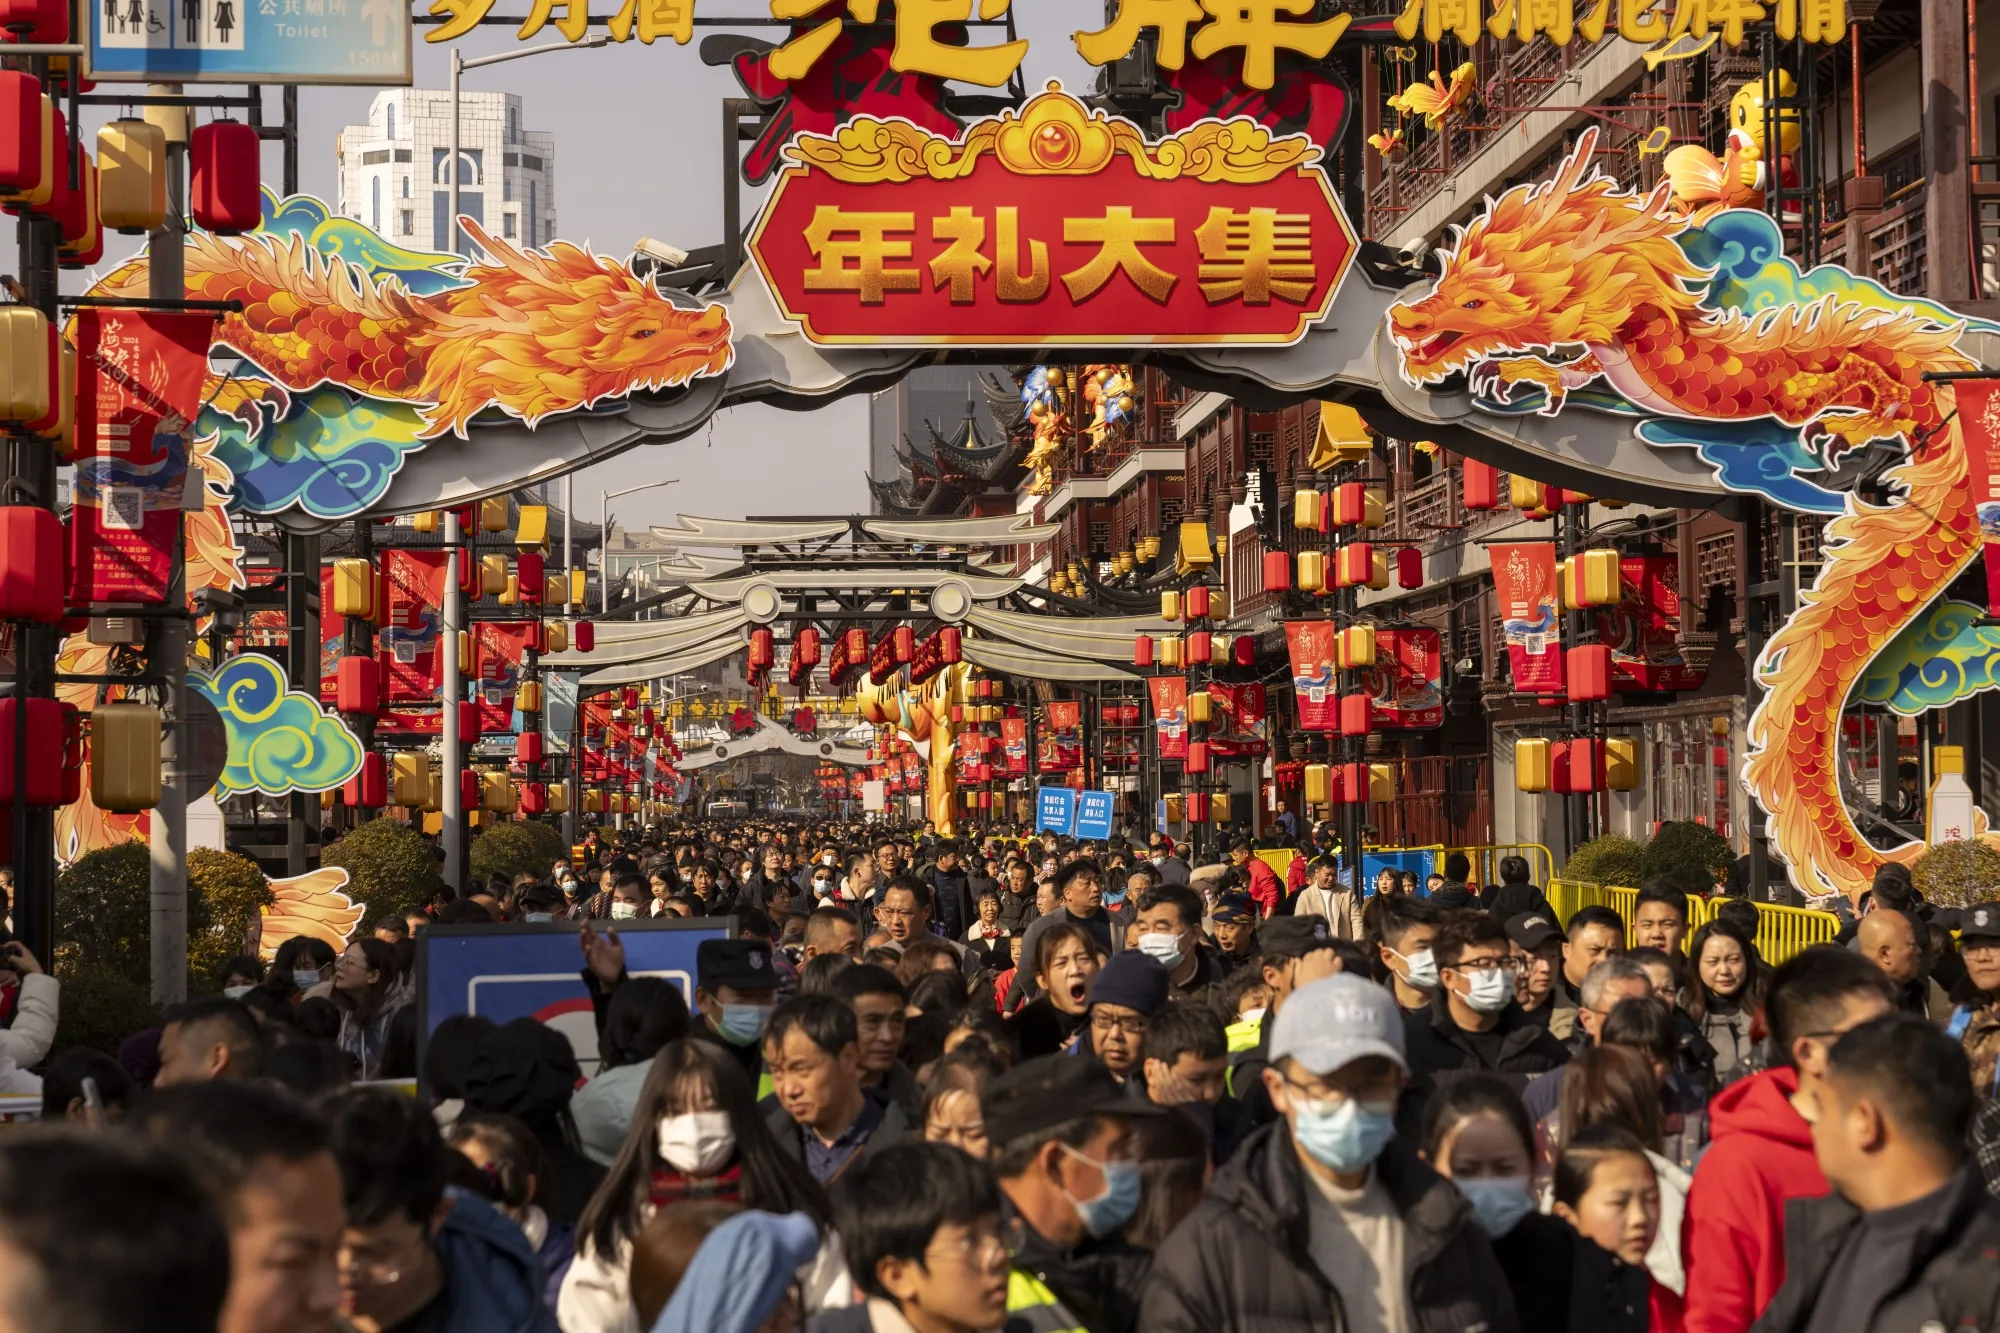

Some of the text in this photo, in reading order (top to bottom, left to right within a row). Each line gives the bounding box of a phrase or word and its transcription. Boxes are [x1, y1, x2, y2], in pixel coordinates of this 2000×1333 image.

[275, 23, 328, 38] Toilet
[803, 205, 1316, 305] 年礼大集
[122, 336, 139, 344] 2024
